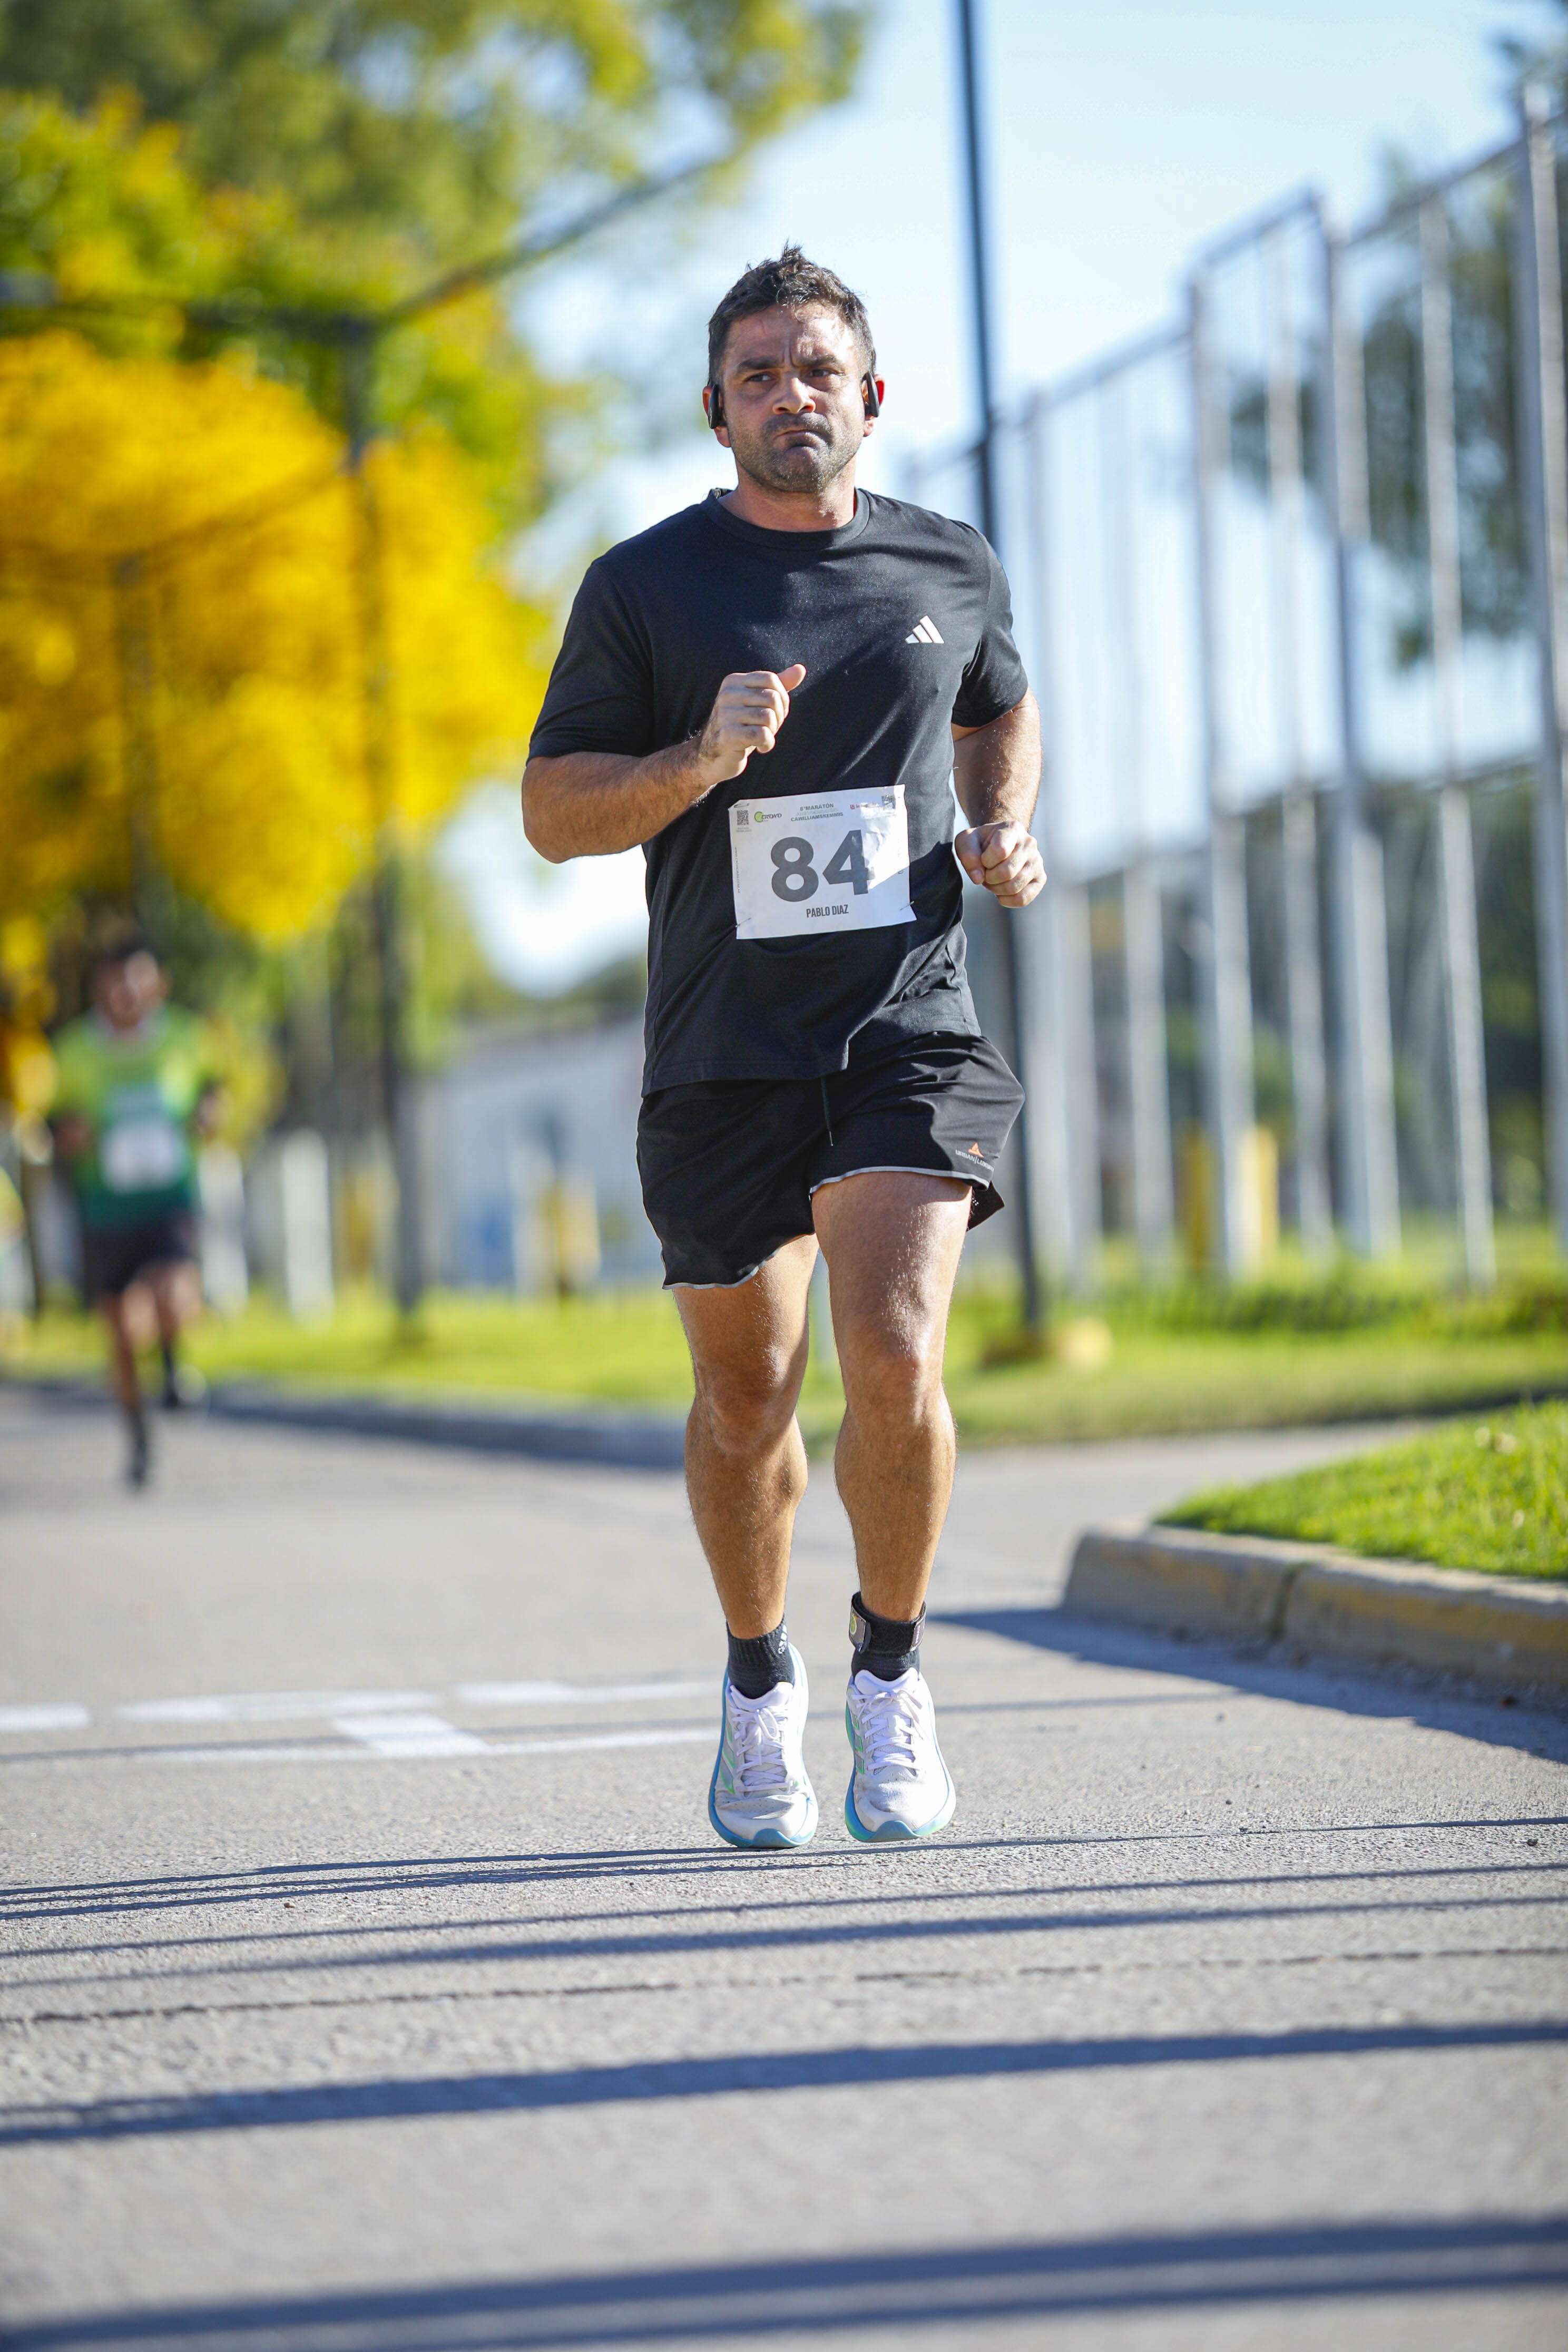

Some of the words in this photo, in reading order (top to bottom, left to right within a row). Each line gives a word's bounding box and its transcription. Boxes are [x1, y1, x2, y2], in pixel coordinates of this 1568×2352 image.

[771, 829, 875, 902] 84
[806, 906, 830, 917] PABLO
[832, 904, 849, 915] DIAZ
